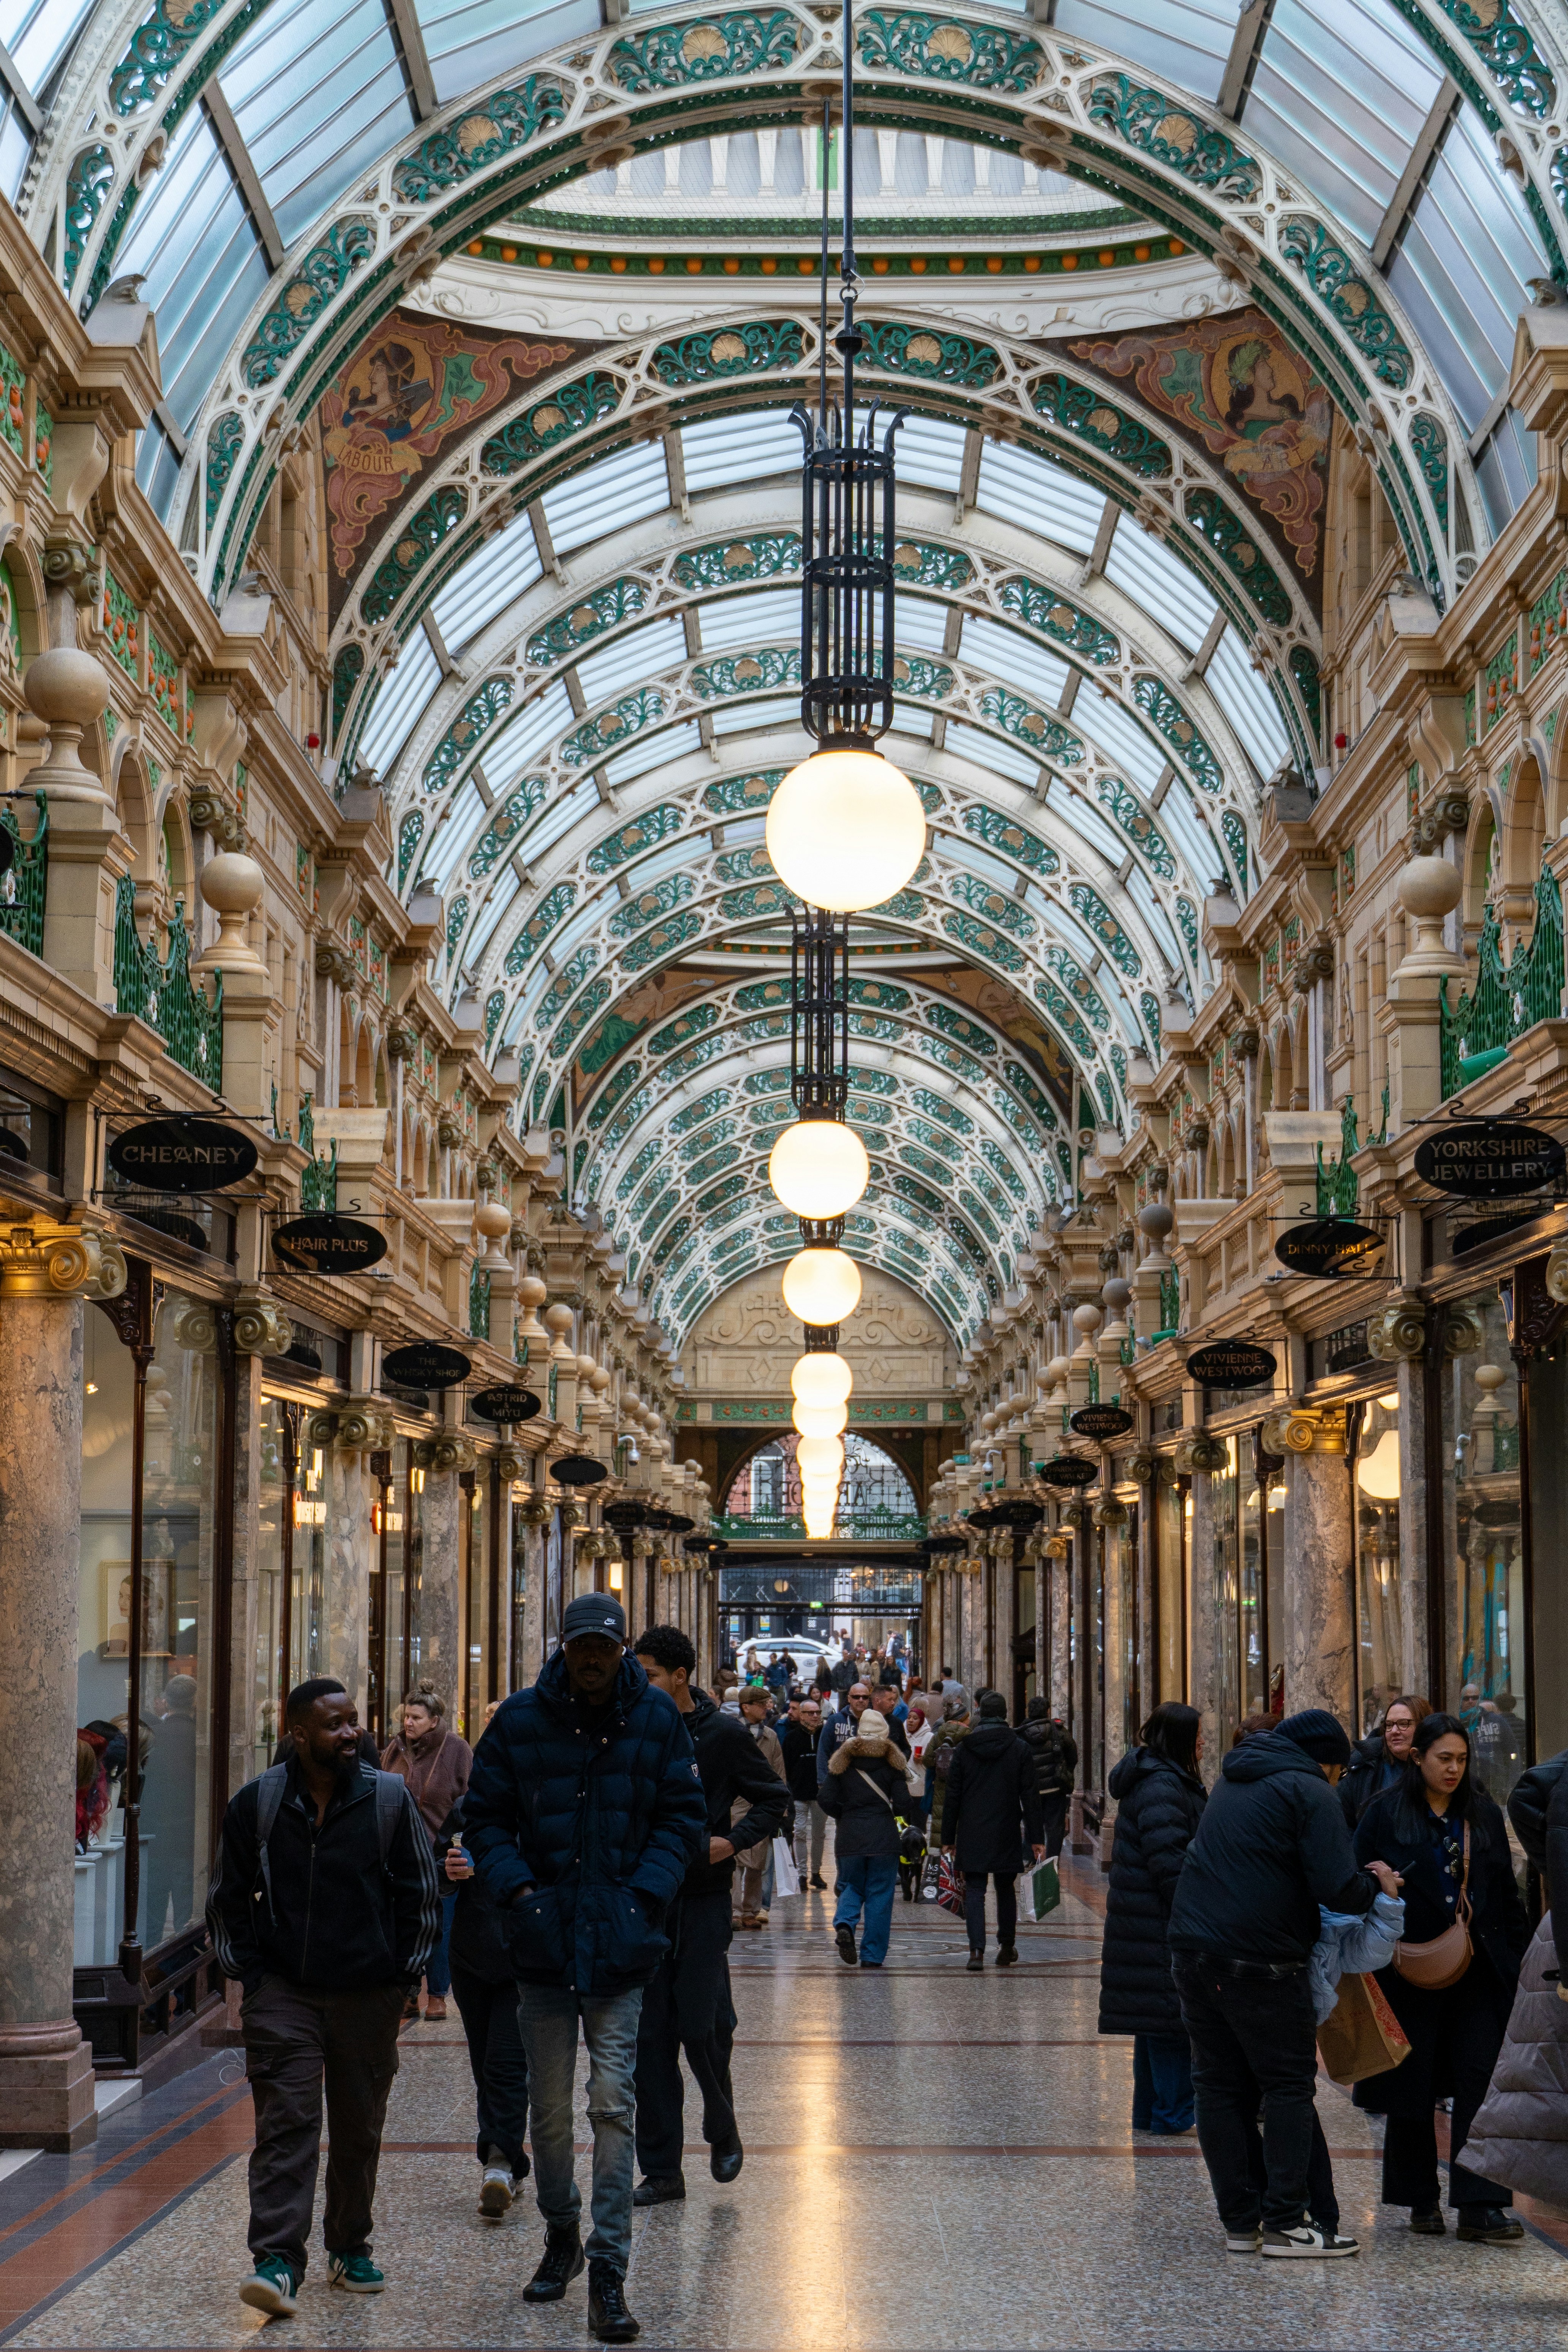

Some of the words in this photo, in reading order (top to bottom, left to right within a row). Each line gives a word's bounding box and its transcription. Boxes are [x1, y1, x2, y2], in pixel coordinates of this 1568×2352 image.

[338, 444, 395, 472] LABOUR
[1262, 446, 1304, 471] ART
[1429, 1139, 1550, 1158] YORKSHIRE
[122, 1145, 247, 1165] CHEANEY
[1429, 1162, 1552, 1181] JEWELLERY
[291, 1237, 328, 1251] HAIR
[332, 1239, 368, 1253] PLUS
[1288, 1244, 1330, 1255] DINNY
[1335, 1243, 1374, 1255] HALL
[418, 1357, 438, 1366] THE
[1203, 1353, 1262, 1364] VIVIENNE
[394, 1368, 433, 1377] WHISKY
[436, 1369, 462, 1378] SHOP
[1193, 1365, 1270, 1377] WESTWOOD
[487, 1394, 528, 1402] ASTRID
[492, 1408, 521, 1417] MIYU
[1083, 1413, 1121, 1422] VIVIENNE
[1077, 1423, 1127, 1431] WESTWOOD
[1045, 1465, 1092, 1473] CHARBONNEL
[835, 1723, 855, 1737] SUPE
